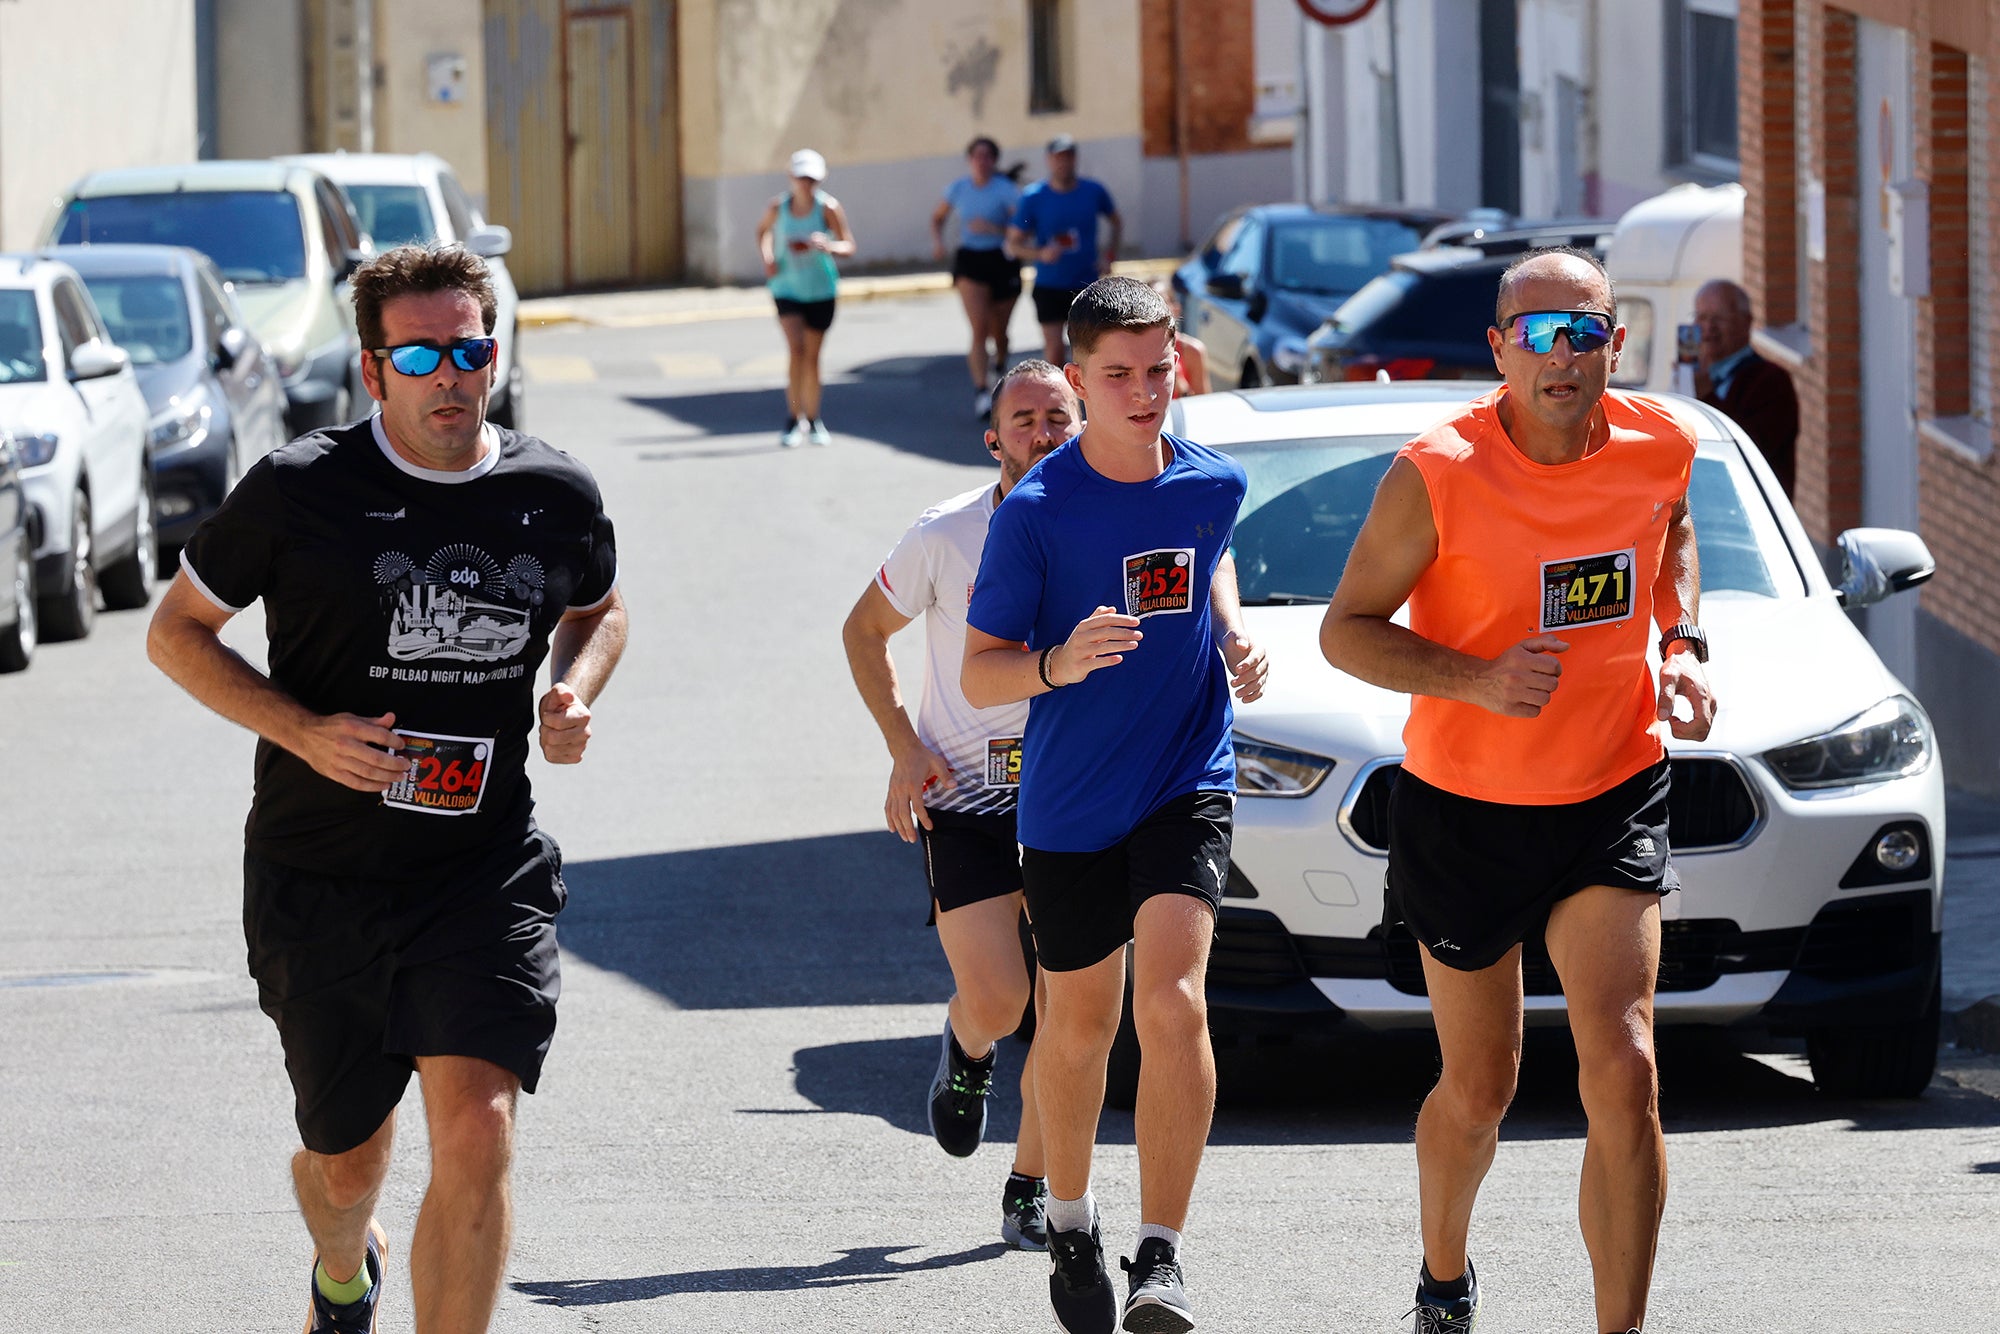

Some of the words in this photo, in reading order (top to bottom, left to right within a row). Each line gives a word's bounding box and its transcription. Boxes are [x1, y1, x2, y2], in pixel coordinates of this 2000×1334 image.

[450, 566, 481, 589] edp
[1140, 566, 1188, 599] 252
[1567, 571, 1624, 606] 471
[1140, 594, 1186, 611] VILLALOBÓN
[1567, 601, 1628, 622] VILLALOBÓN
[369, 665, 389, 679] EDP
[392, 668, 428, 682] BILBAO
[431, 670, 460, 683] NIGHT
[417, 756, 483, 793] 264
[414, 791, 477, 808] VILLALOBÓN
